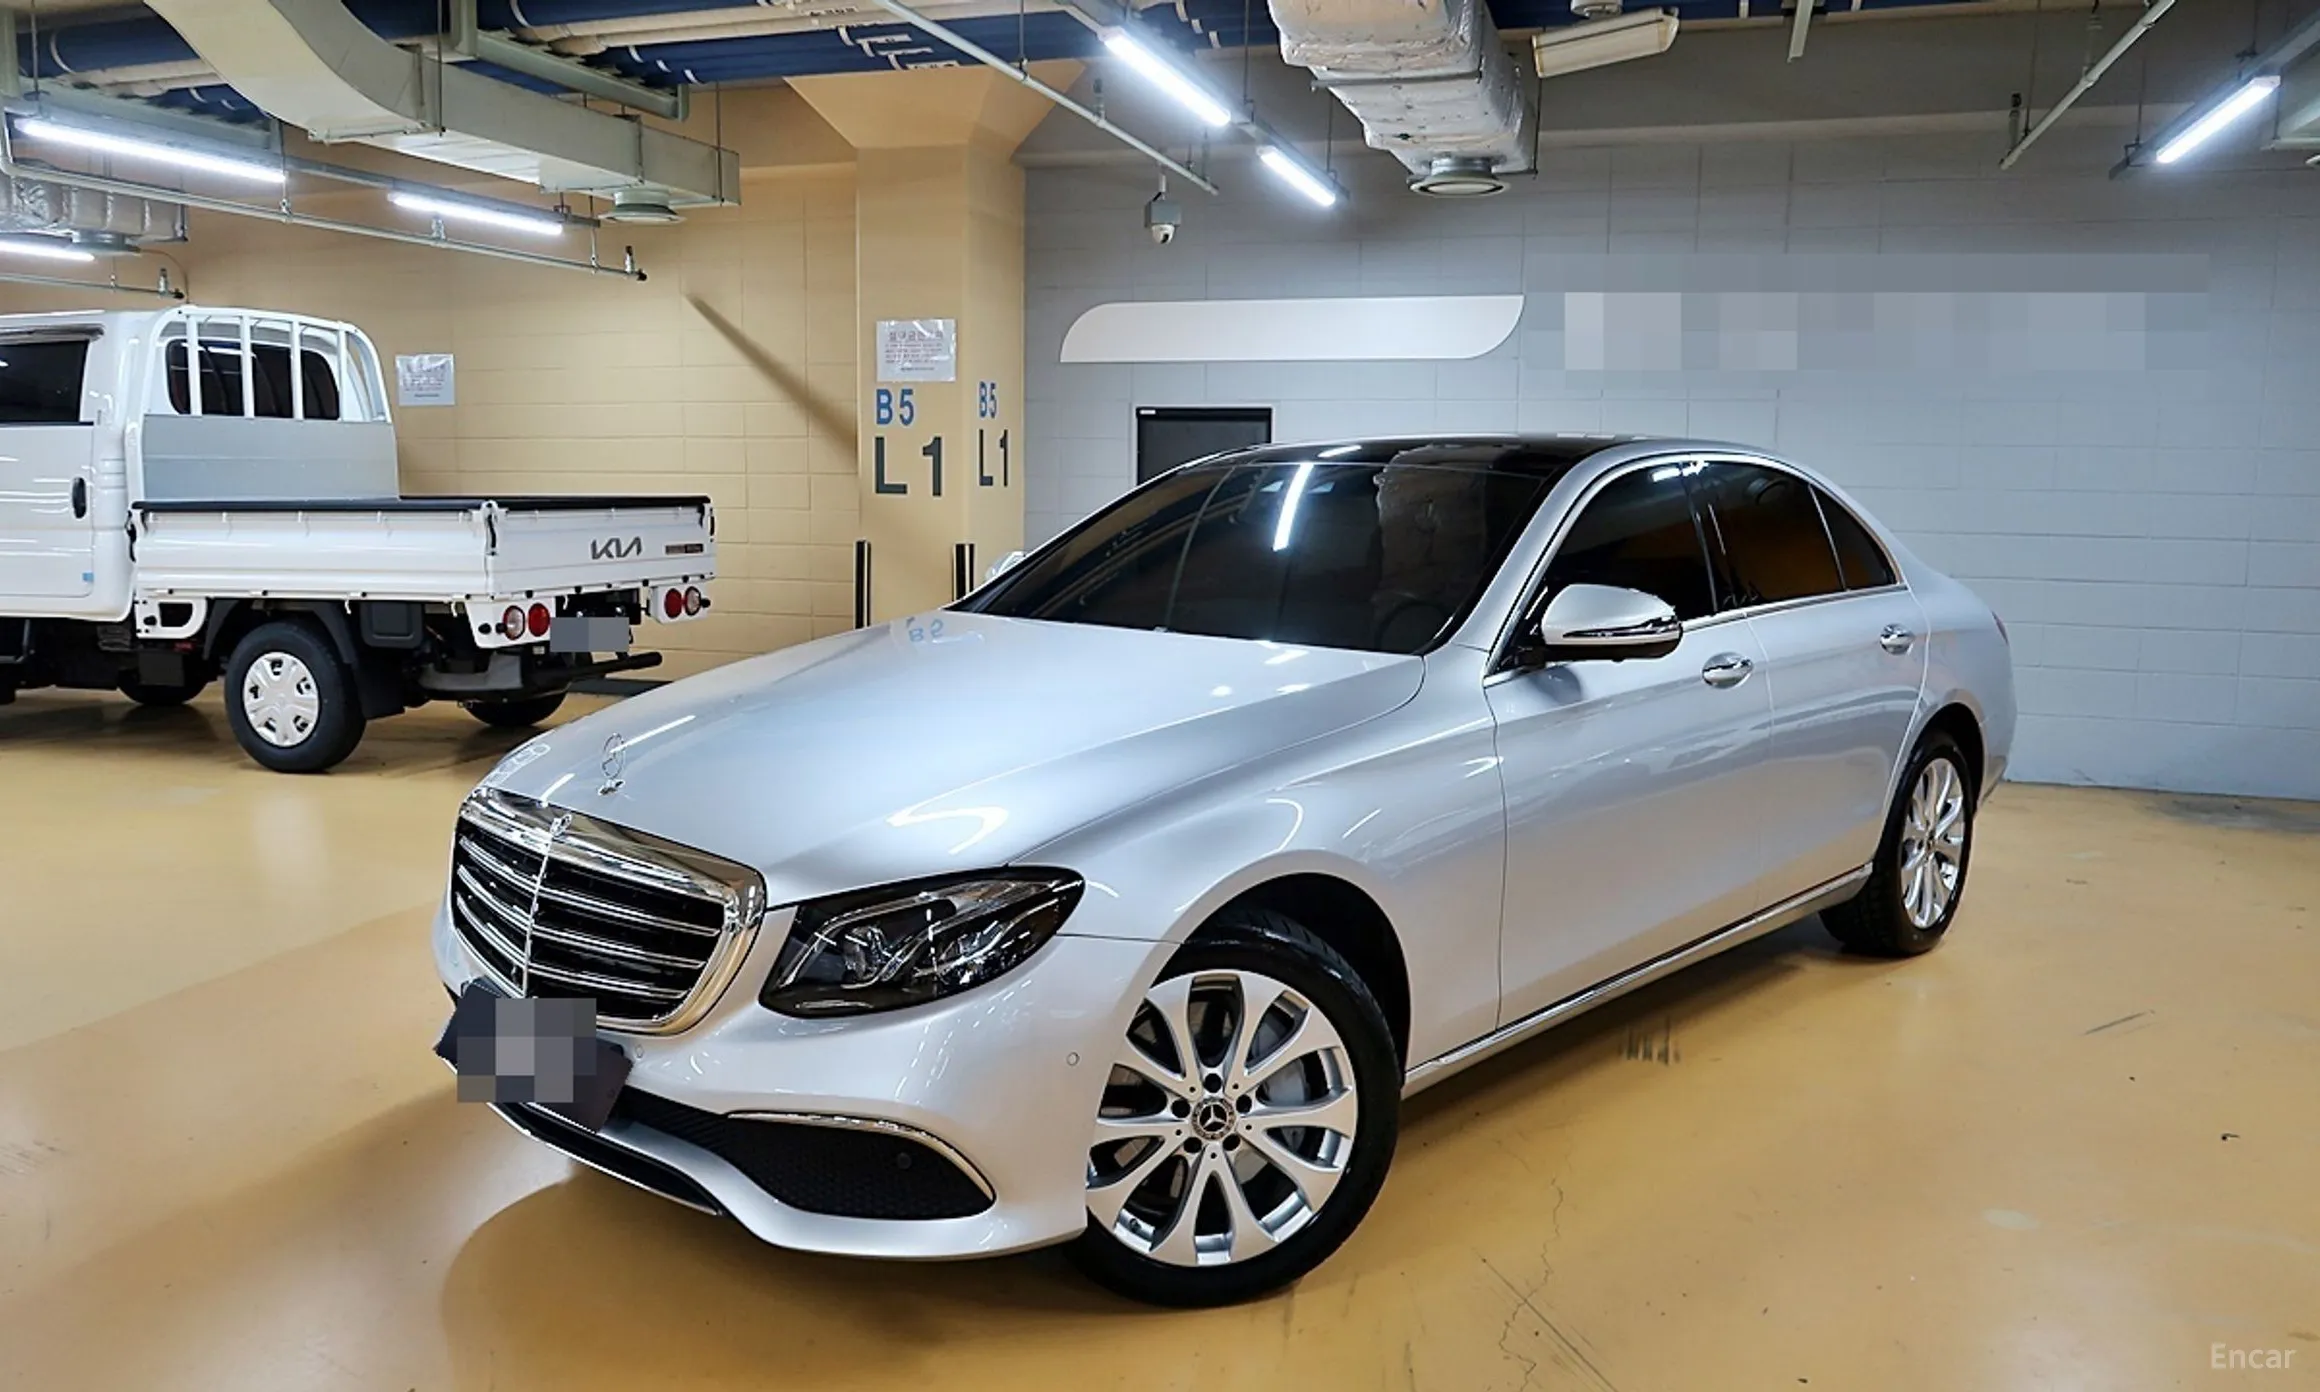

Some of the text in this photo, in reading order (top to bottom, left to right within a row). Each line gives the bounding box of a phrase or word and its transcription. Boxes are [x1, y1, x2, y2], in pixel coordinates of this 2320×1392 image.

[876, 388, 915, 426] B5
[979, 381, 997, 419] B5
[875, 436, 942, 497] L1
[979, 429, 1008, 487] L1
[590, 536, 642, 560] KIA
